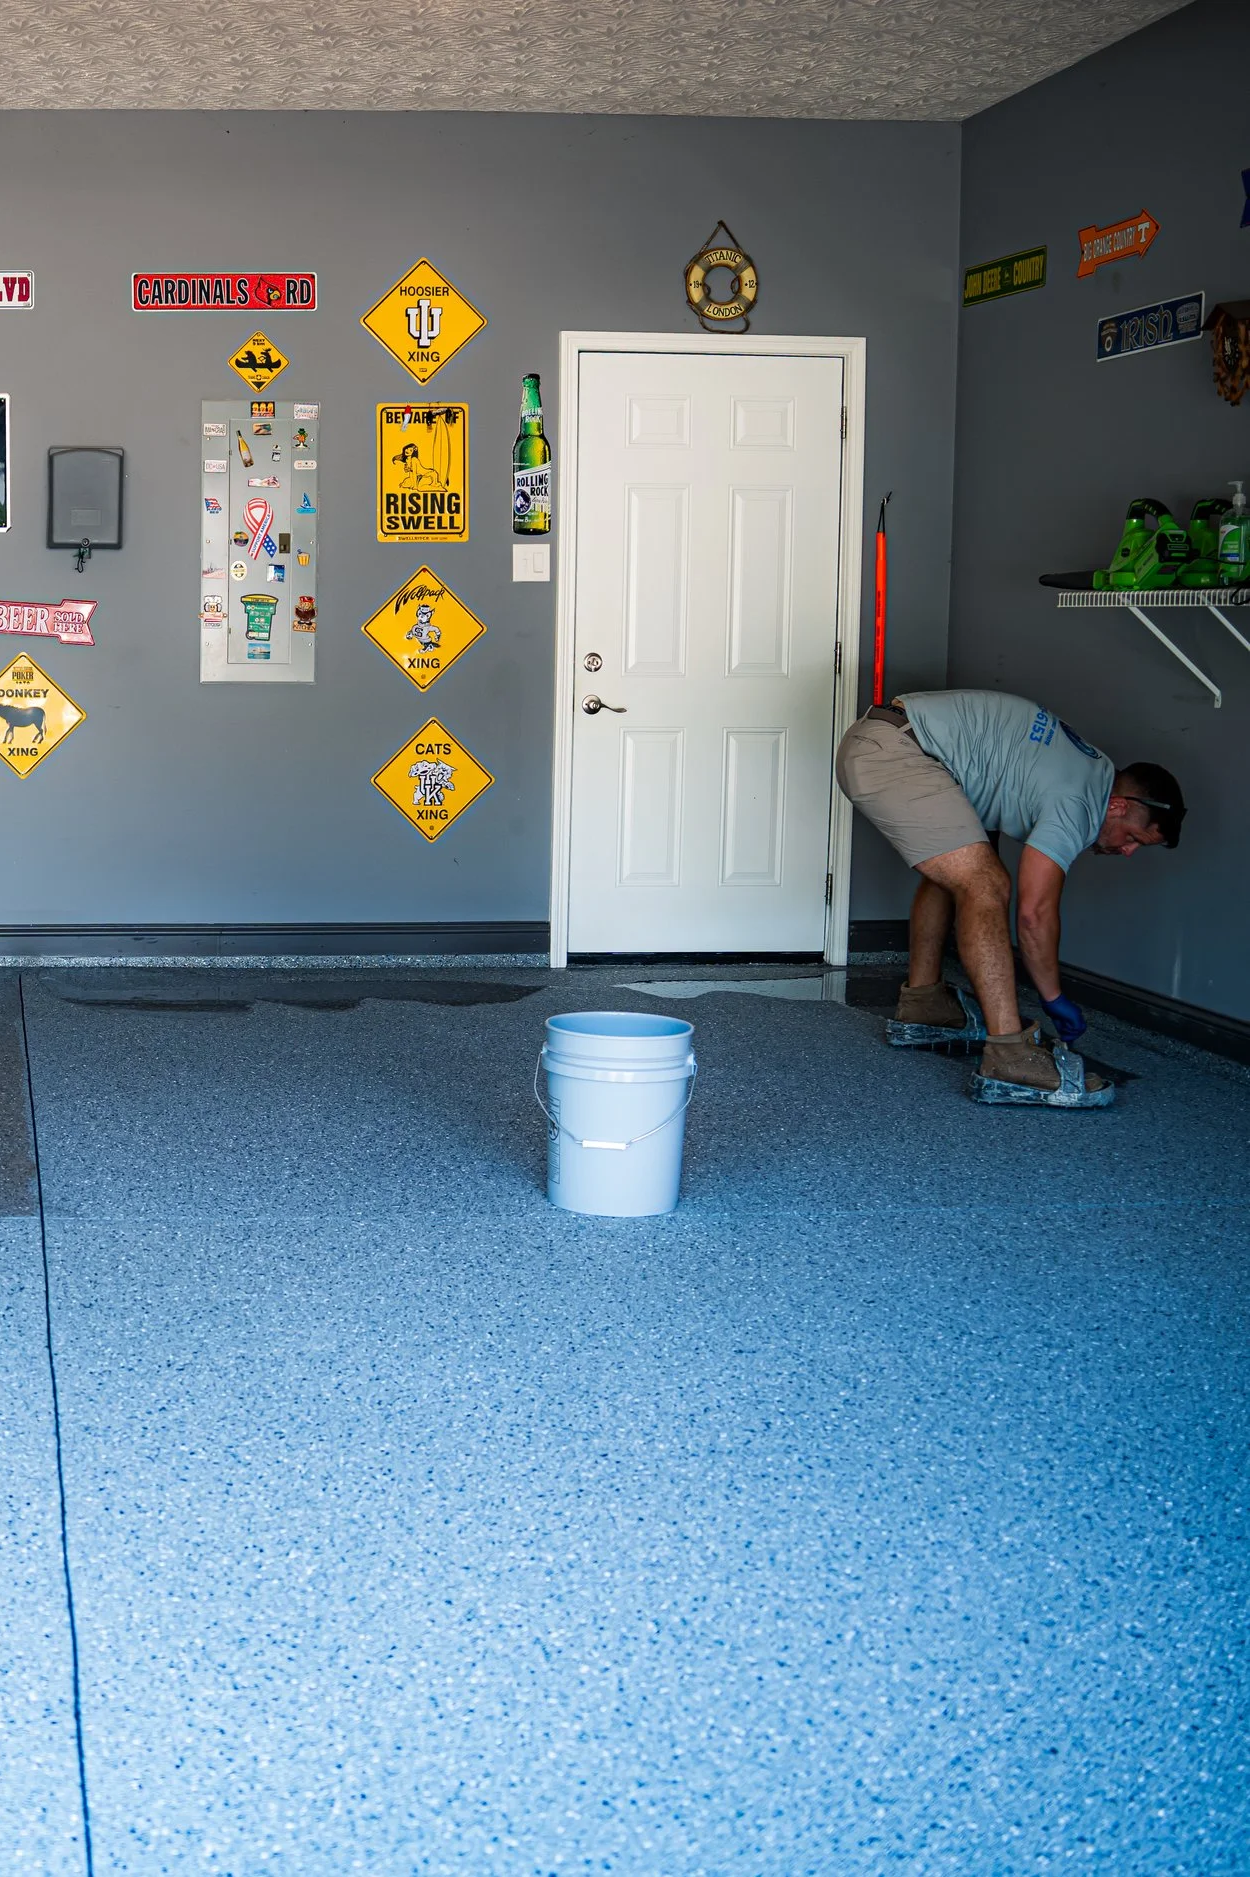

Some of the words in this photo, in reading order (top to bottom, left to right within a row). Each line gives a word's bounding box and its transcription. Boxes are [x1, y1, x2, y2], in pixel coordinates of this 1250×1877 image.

[1083, 242, 1092, 262] BIG
[1093, 232, 1112, 258] ORANGE
[1113, 226, 1136, 252] COUNTRY
[705, 250, 742, 263] TITANIC
[964, 272, 982, 299] JOHN
[982, 266, 1002, 294] DEERE
[1013, 254, 1044, 287] COUNTRY
[748, 280, 755, 288] 12
[137, 279, 250, 306] CARDINALS
[285, 279, 313, 306] RD
[400, 286, 449, 296] HOOSIER
[706, 304, 743, 316] LONDON
[408, 352, 440, 362] XING
[517, 473, 549, 488] ROLLING
[530, 485, 549, 497] ROCK
[386, 493, 460, 515] RISING
[386, 516, 460, 530] SWELL
[252, 532, 263, 553] SUPPORT
[260, 514, 271, 533] AMERICA
[394, 585, 445, 615] Wolfpack
[54, 612, 84, 623] SOLD
[54, 622, 83, 633] HERE
[408, 658, 440, 669] XING
[12, 671, 34, 680] POKER
[8, 748, 38, 756] XING
[415, 743, 451, 755] CATS
[416, 809, 448, 820] XING
